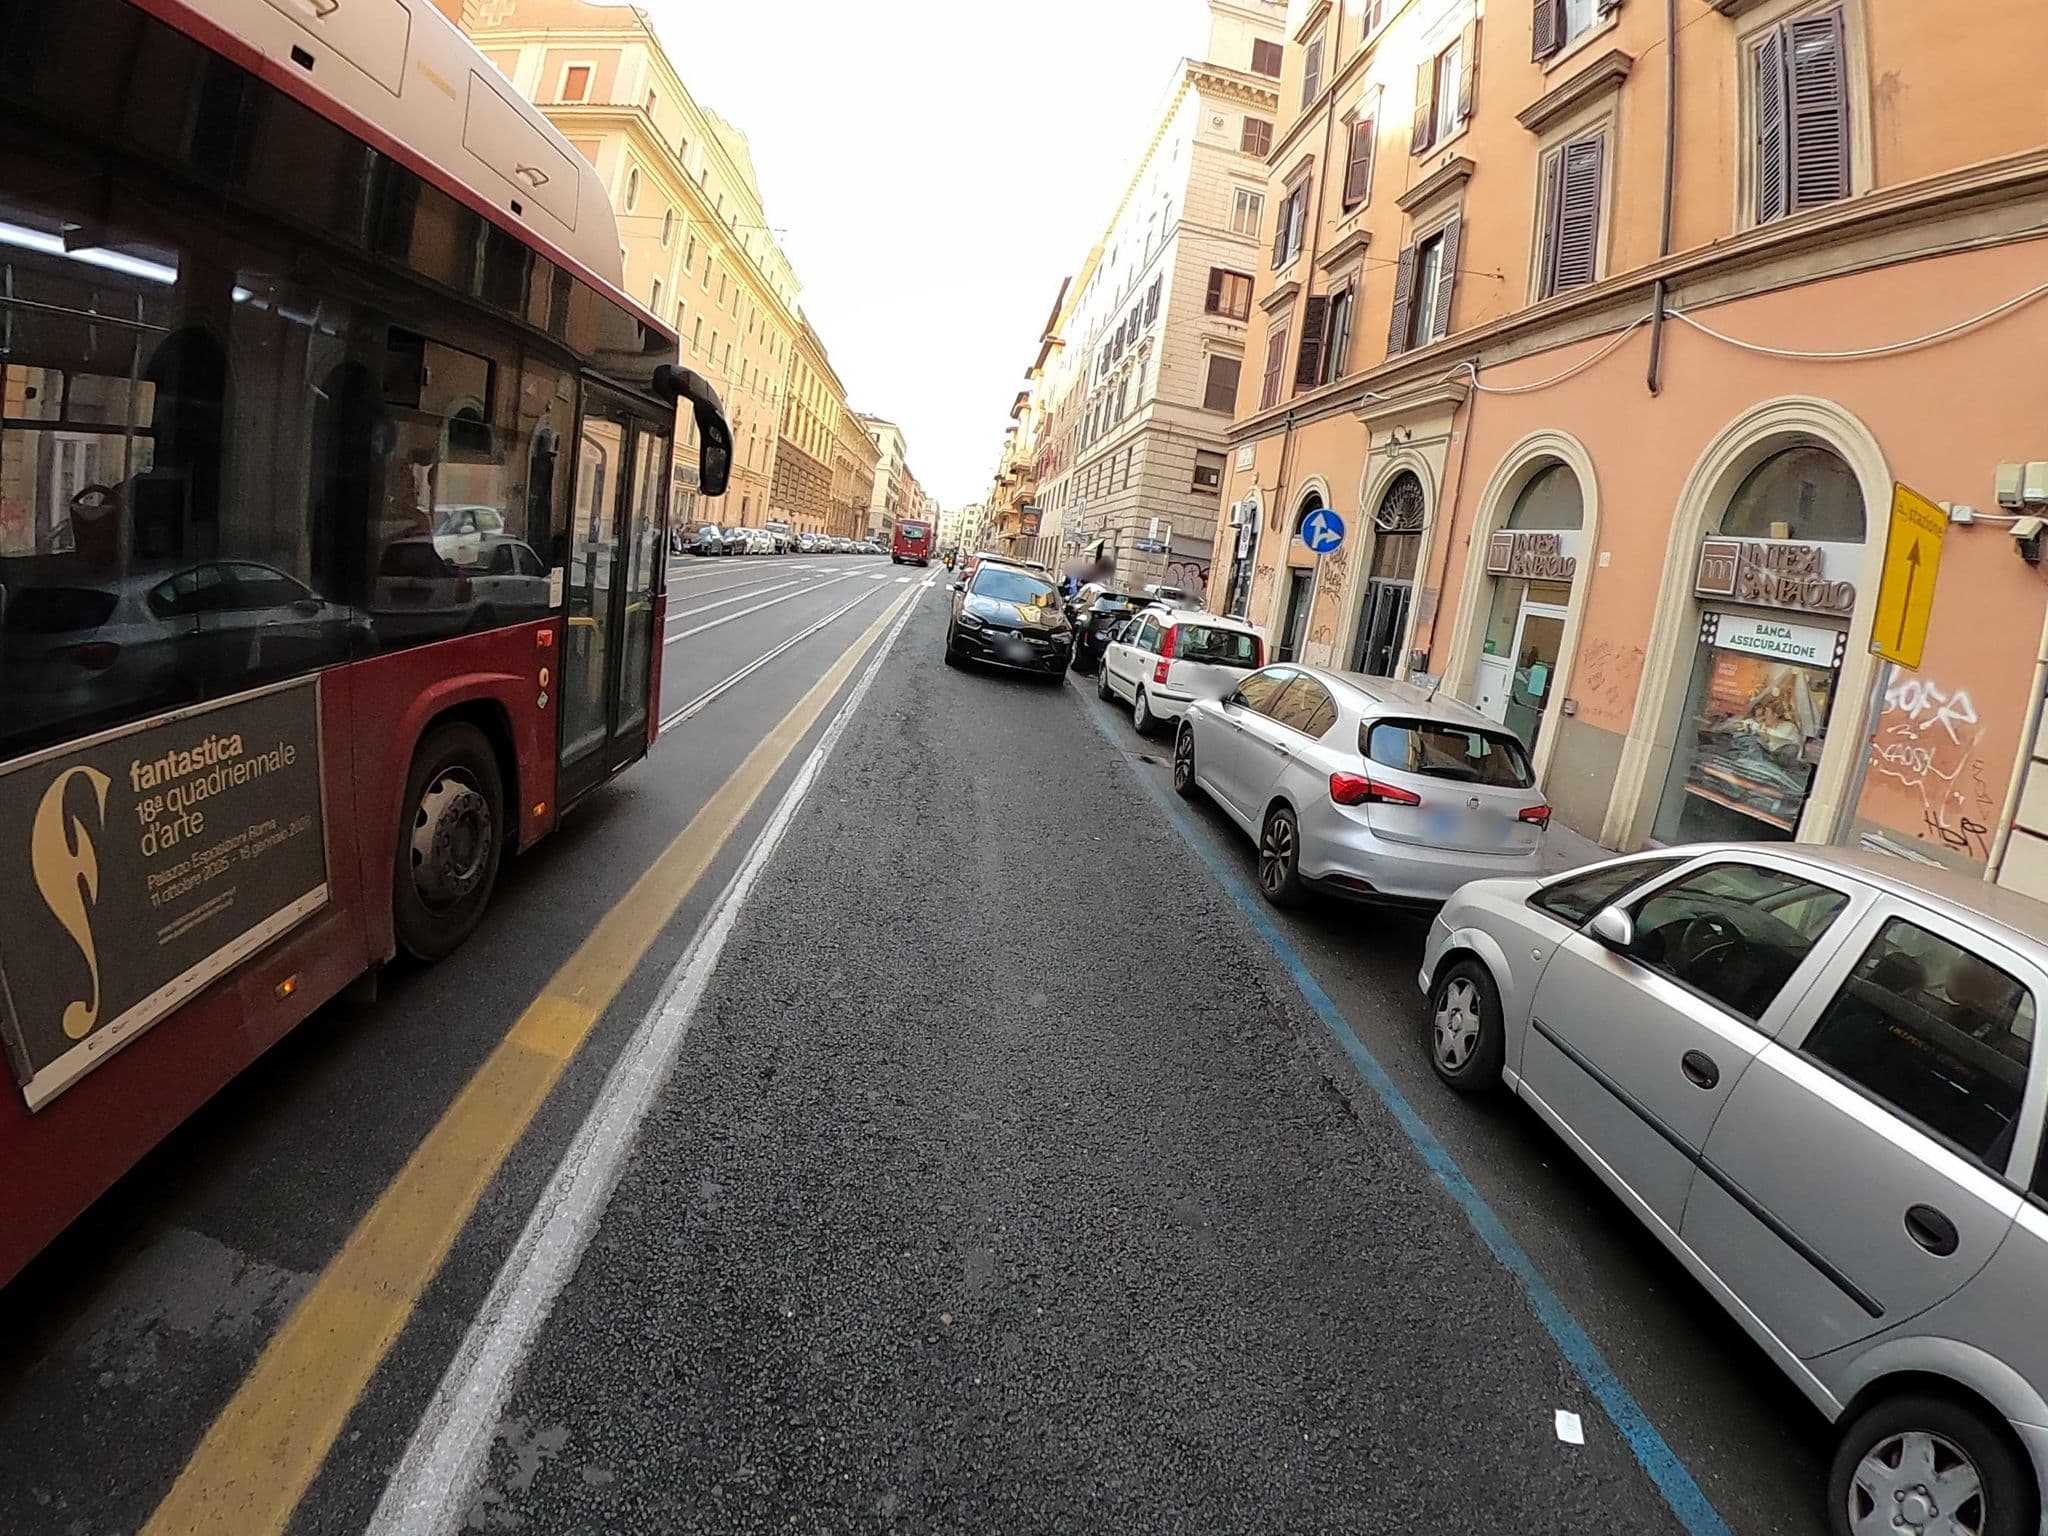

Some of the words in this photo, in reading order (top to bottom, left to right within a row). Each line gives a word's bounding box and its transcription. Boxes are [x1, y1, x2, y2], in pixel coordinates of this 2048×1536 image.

[1516, 533, 1562, 556] INTESA
[1742, 542, 1824, 578] INTESA
[1741, 567, 1857, 611] SANPAOLO
[1729, 635, 1817, 659] ASSICURAZIONE
[1755, 624, 1792, 640] BANCA
[129, 733, 244, 793] fantastica
[166, 741, 297, 814] quadriennale
[141, 811, 204, 857] d'arte
[248, 818, 277, 840] Roma
